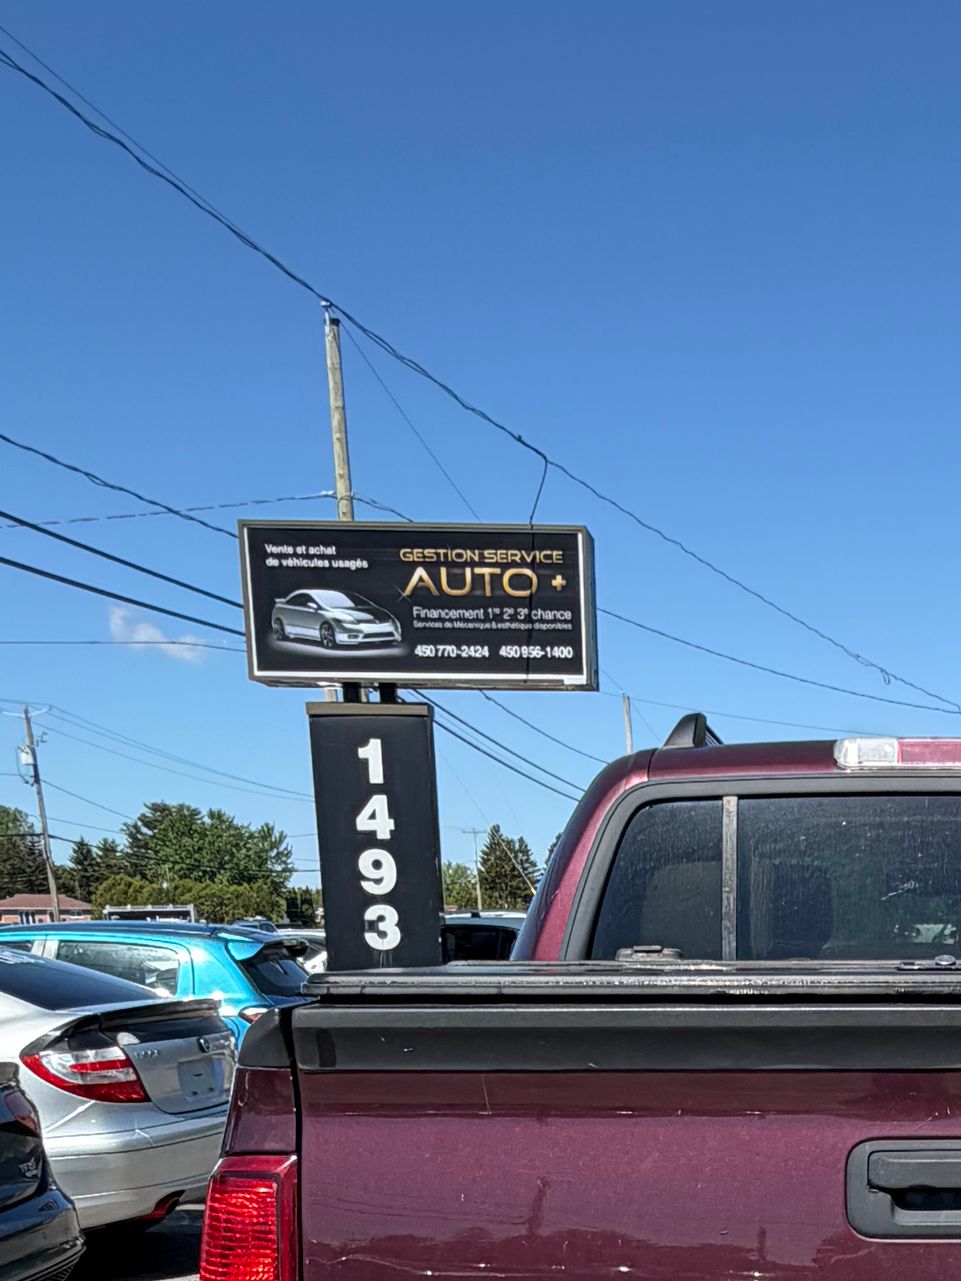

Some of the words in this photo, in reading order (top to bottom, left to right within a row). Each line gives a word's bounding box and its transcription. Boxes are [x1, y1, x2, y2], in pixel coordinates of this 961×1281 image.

[264, 543, 294, 554] Vente
[296, 544, 307, 555] et
[308, 544, 336, 555] achat
[400, 548, 479, 563] GESTION
[484, 550, 563, 564] SERVICE
[265, 557, 280, 567] de
[281, 557, 330, 569] véhicules
[403, 566, 538, 597] AUTO
[412, 606, 484, 620] Financement
[531, 608, 573, 621] chance
[414, 644, 436, 658] 450
[436, 644, 490, 658] 770-2424
[499, 645, 521, 659] 450
[521, 645, 574, 659] 956-1400
[355, 738, 402, 951] 1493
